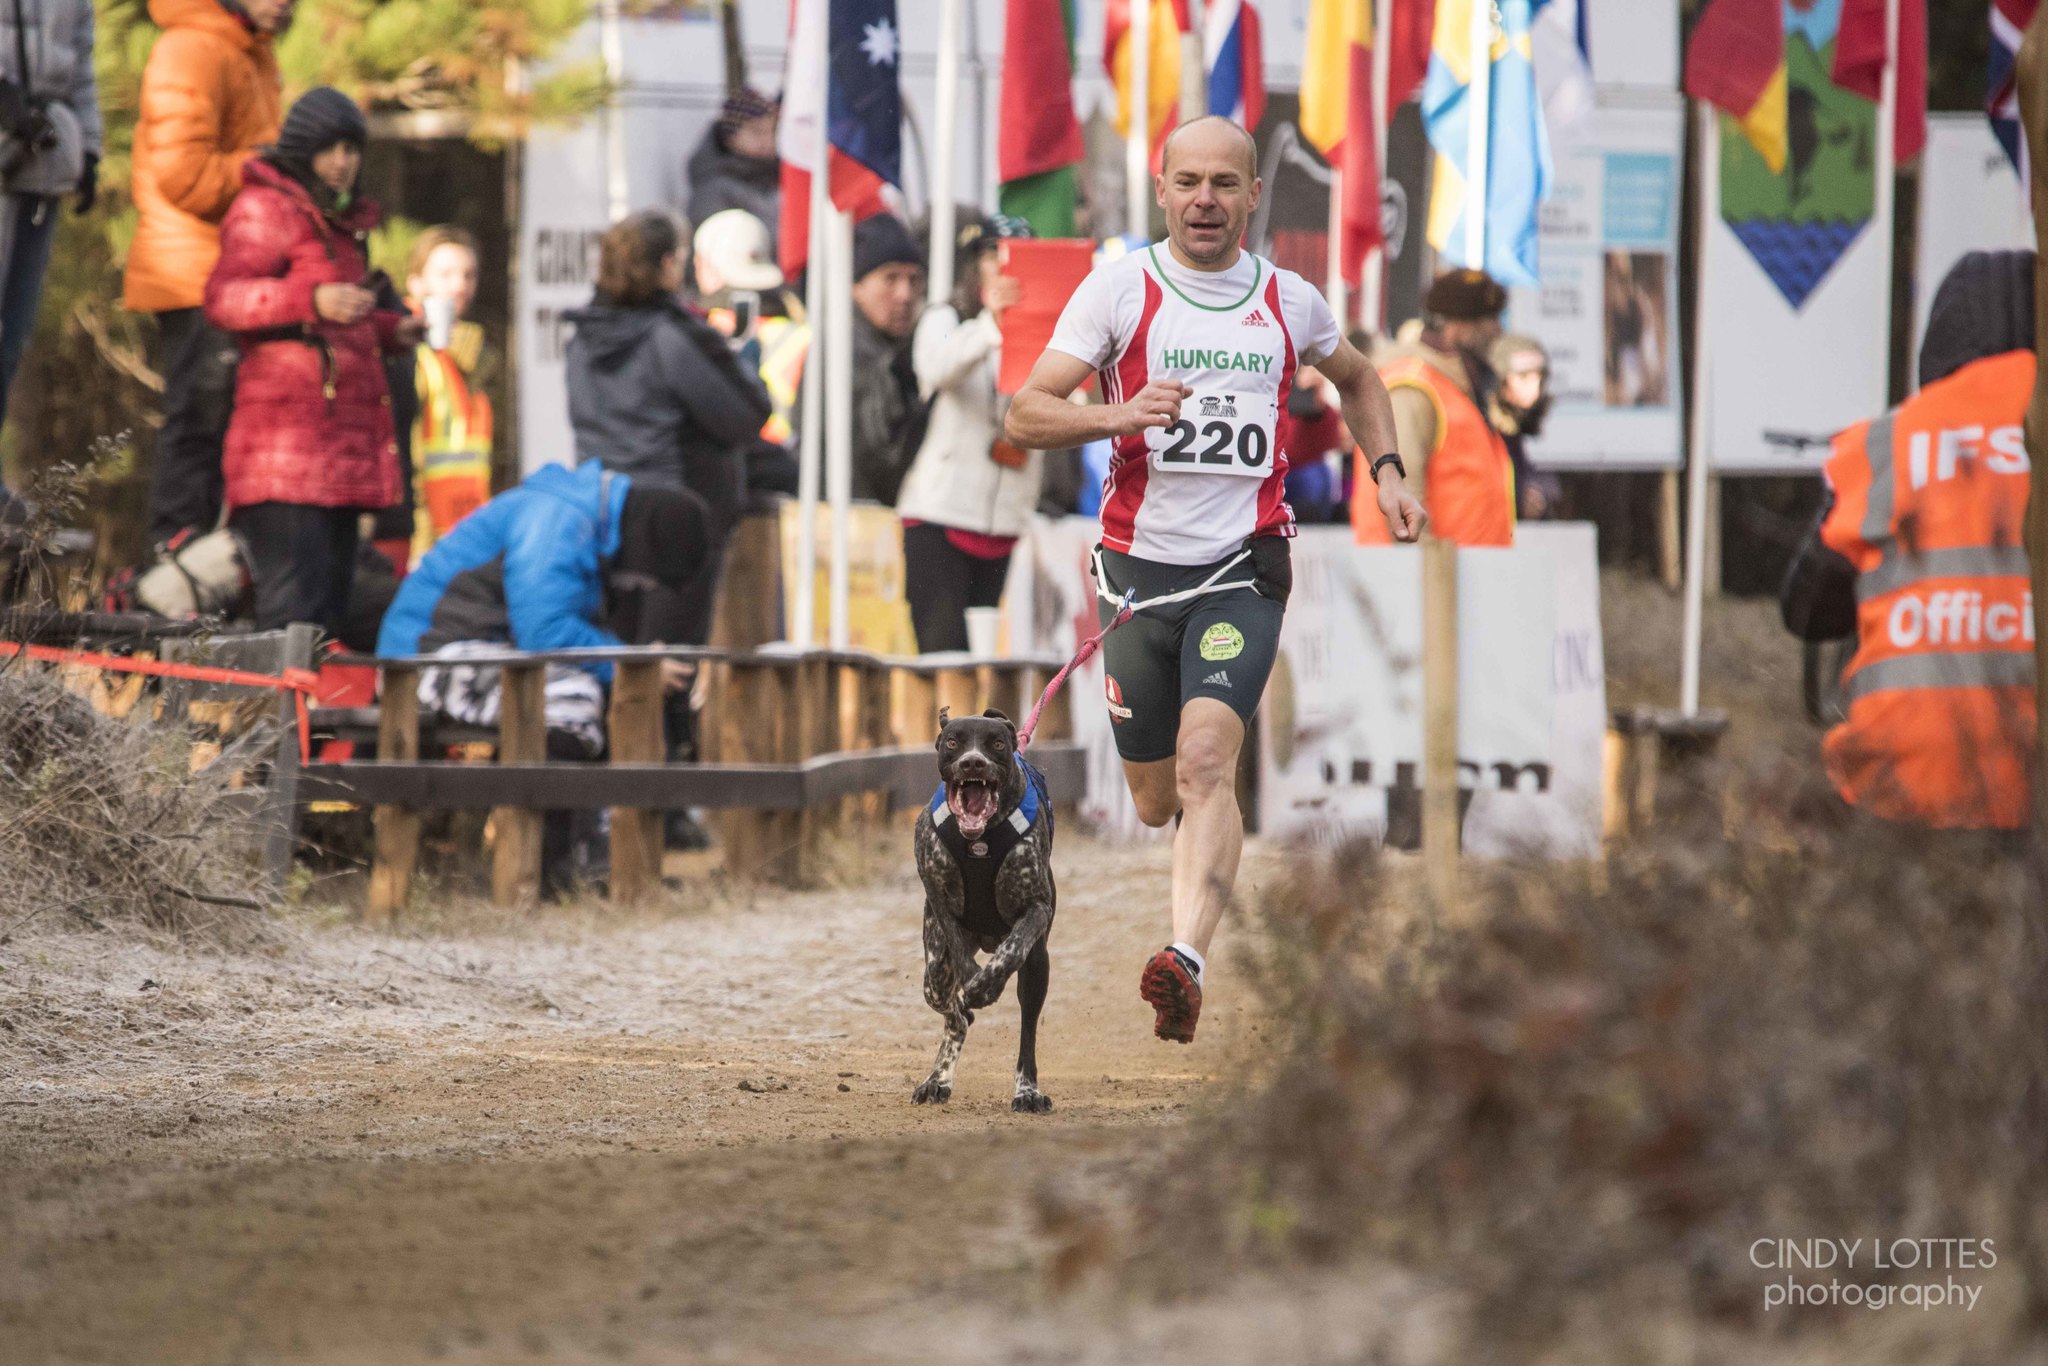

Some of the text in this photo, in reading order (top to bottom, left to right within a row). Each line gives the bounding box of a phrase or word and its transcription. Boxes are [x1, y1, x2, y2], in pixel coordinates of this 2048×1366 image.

[1241, 319, 1270, 328] adidas
[1163, 348, 1274, 375] HUNGARY
[1162, 419, 1268, 468] 220
[1888, 590, 2035, 647] Offici
[1202, 678, 1233, 688] adidas
